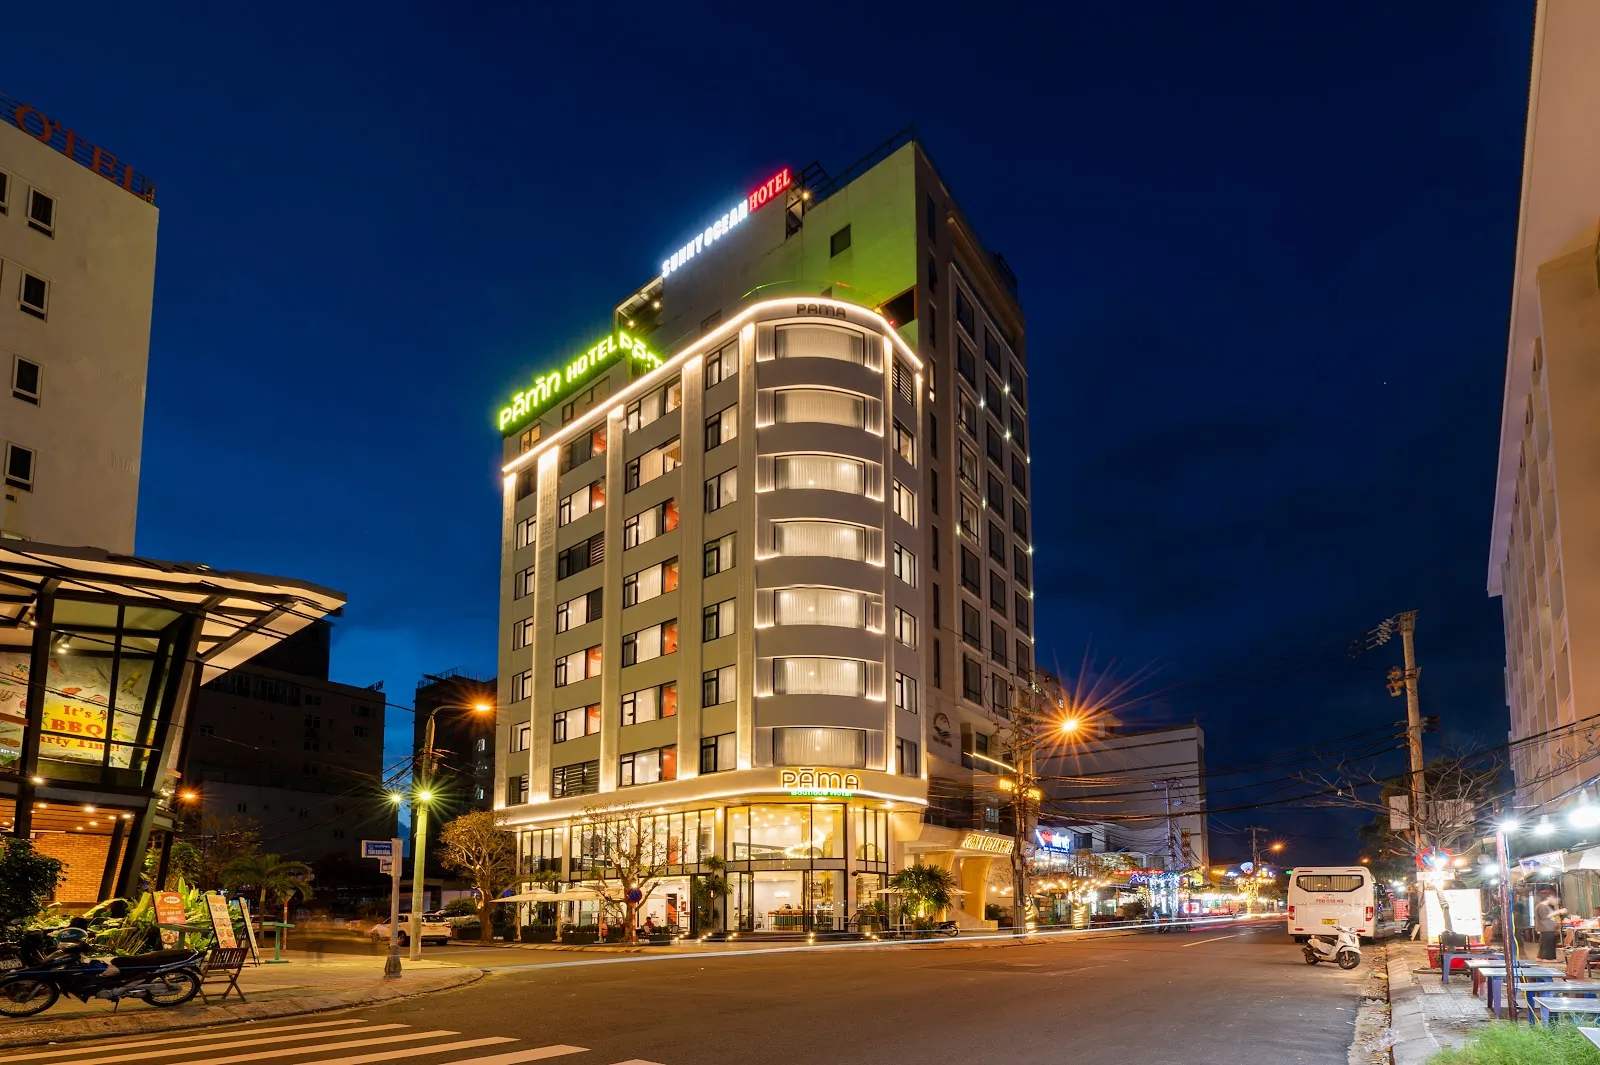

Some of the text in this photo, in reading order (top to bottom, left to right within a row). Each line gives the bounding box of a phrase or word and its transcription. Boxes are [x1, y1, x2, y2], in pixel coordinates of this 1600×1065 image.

[661, 168, 791, 278] SUNNY OCEAN HOTEL
[566, 335, 618, 383] HOTEL
[40, 734, 70, 747] arty
[51, 718, 104, 738] BBQ
